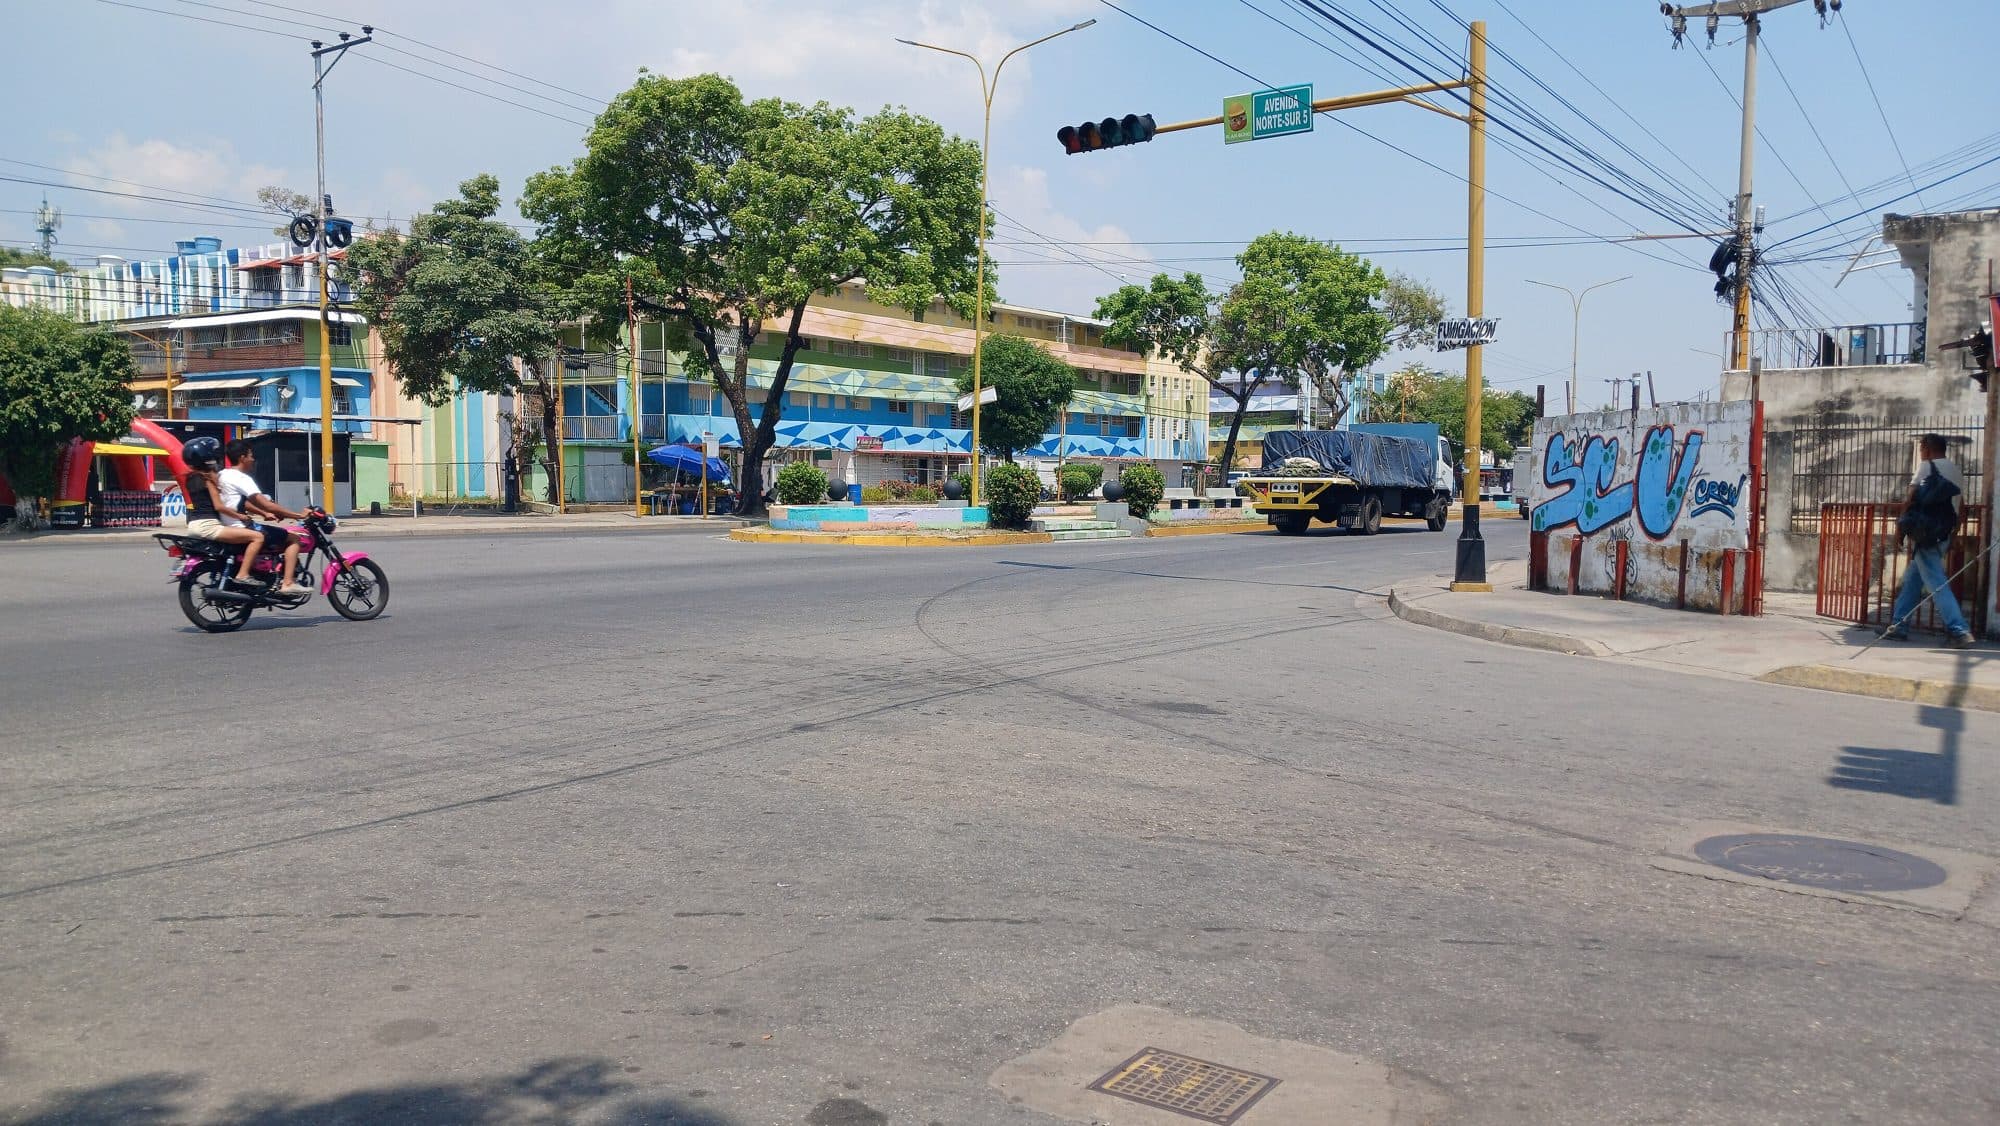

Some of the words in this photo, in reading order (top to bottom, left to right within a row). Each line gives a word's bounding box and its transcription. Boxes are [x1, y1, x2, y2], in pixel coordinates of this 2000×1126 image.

[1264, 94, 1299, 112] AVENIDA
[1255, 111, 1301, 131] NORTE-SUR
[1303, 109, 1308, 124] 5
